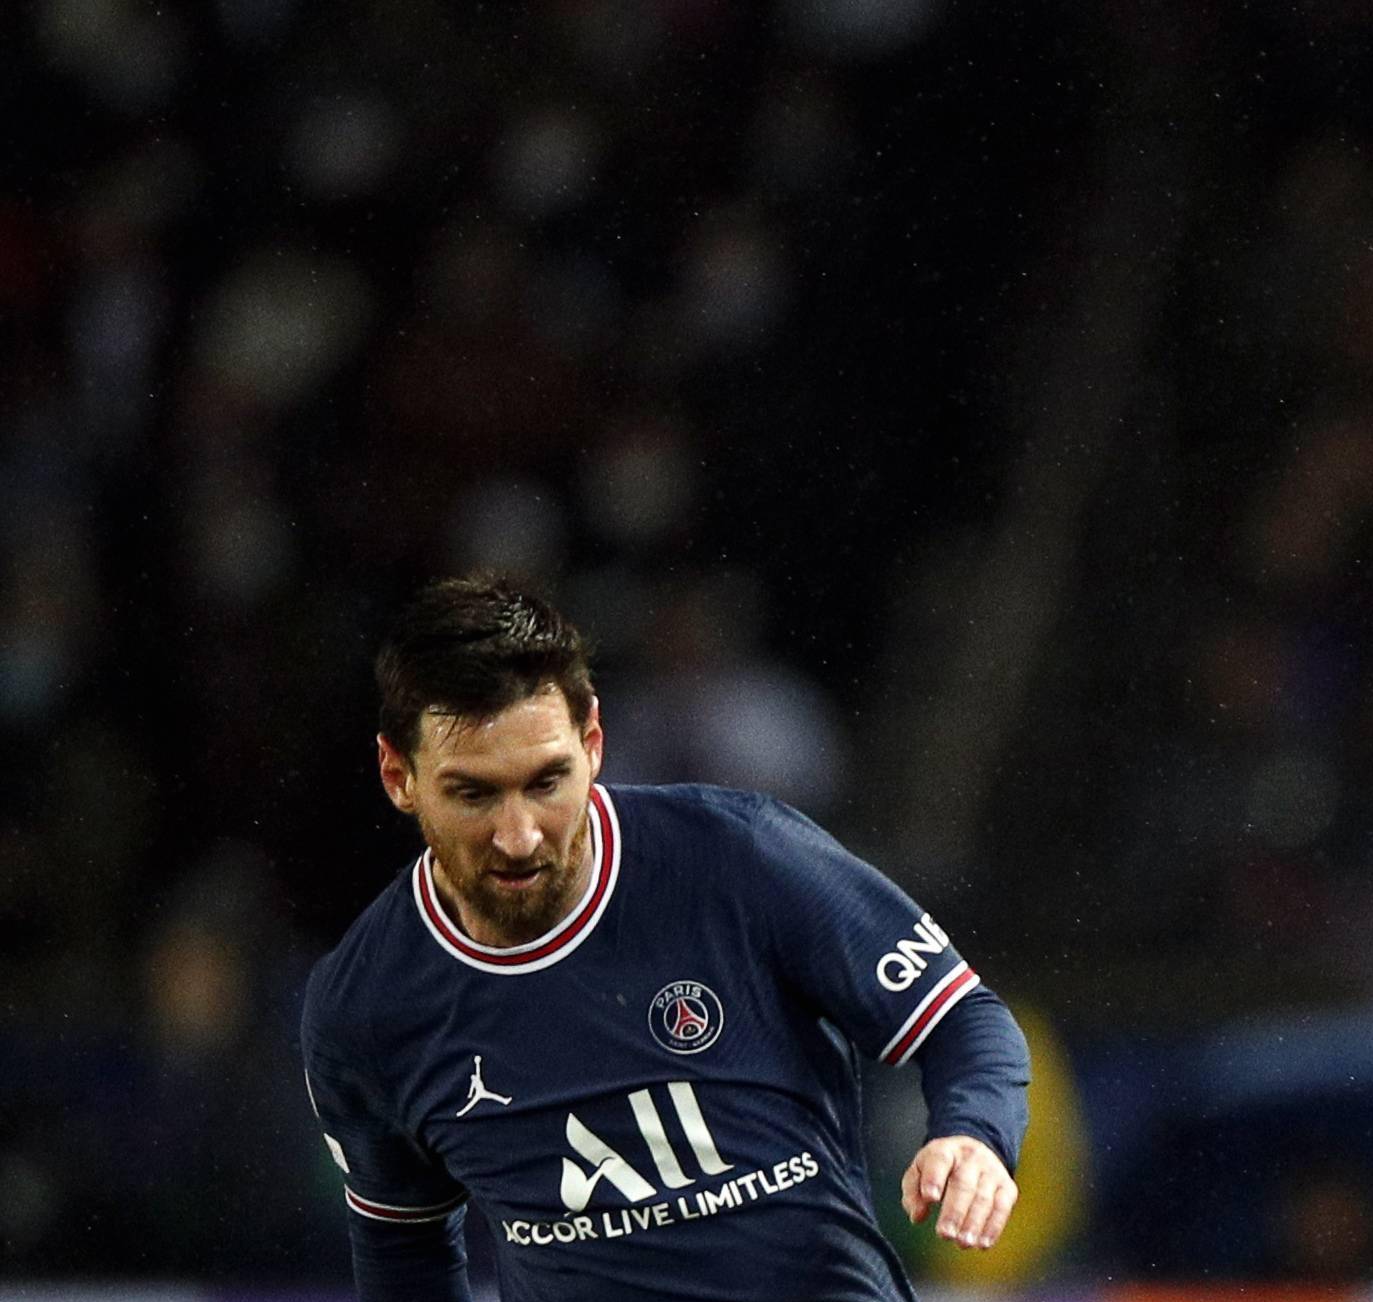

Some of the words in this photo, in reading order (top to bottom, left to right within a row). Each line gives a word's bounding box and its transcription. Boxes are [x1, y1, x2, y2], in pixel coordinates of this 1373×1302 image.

[655, 984, 702, 1009] PARIS
[501, 1215, 599, 1247] ACCOR
[602, 1202, 675, 1240] LIVE
[677, 1151, 820, 1221] LIMITLESS
